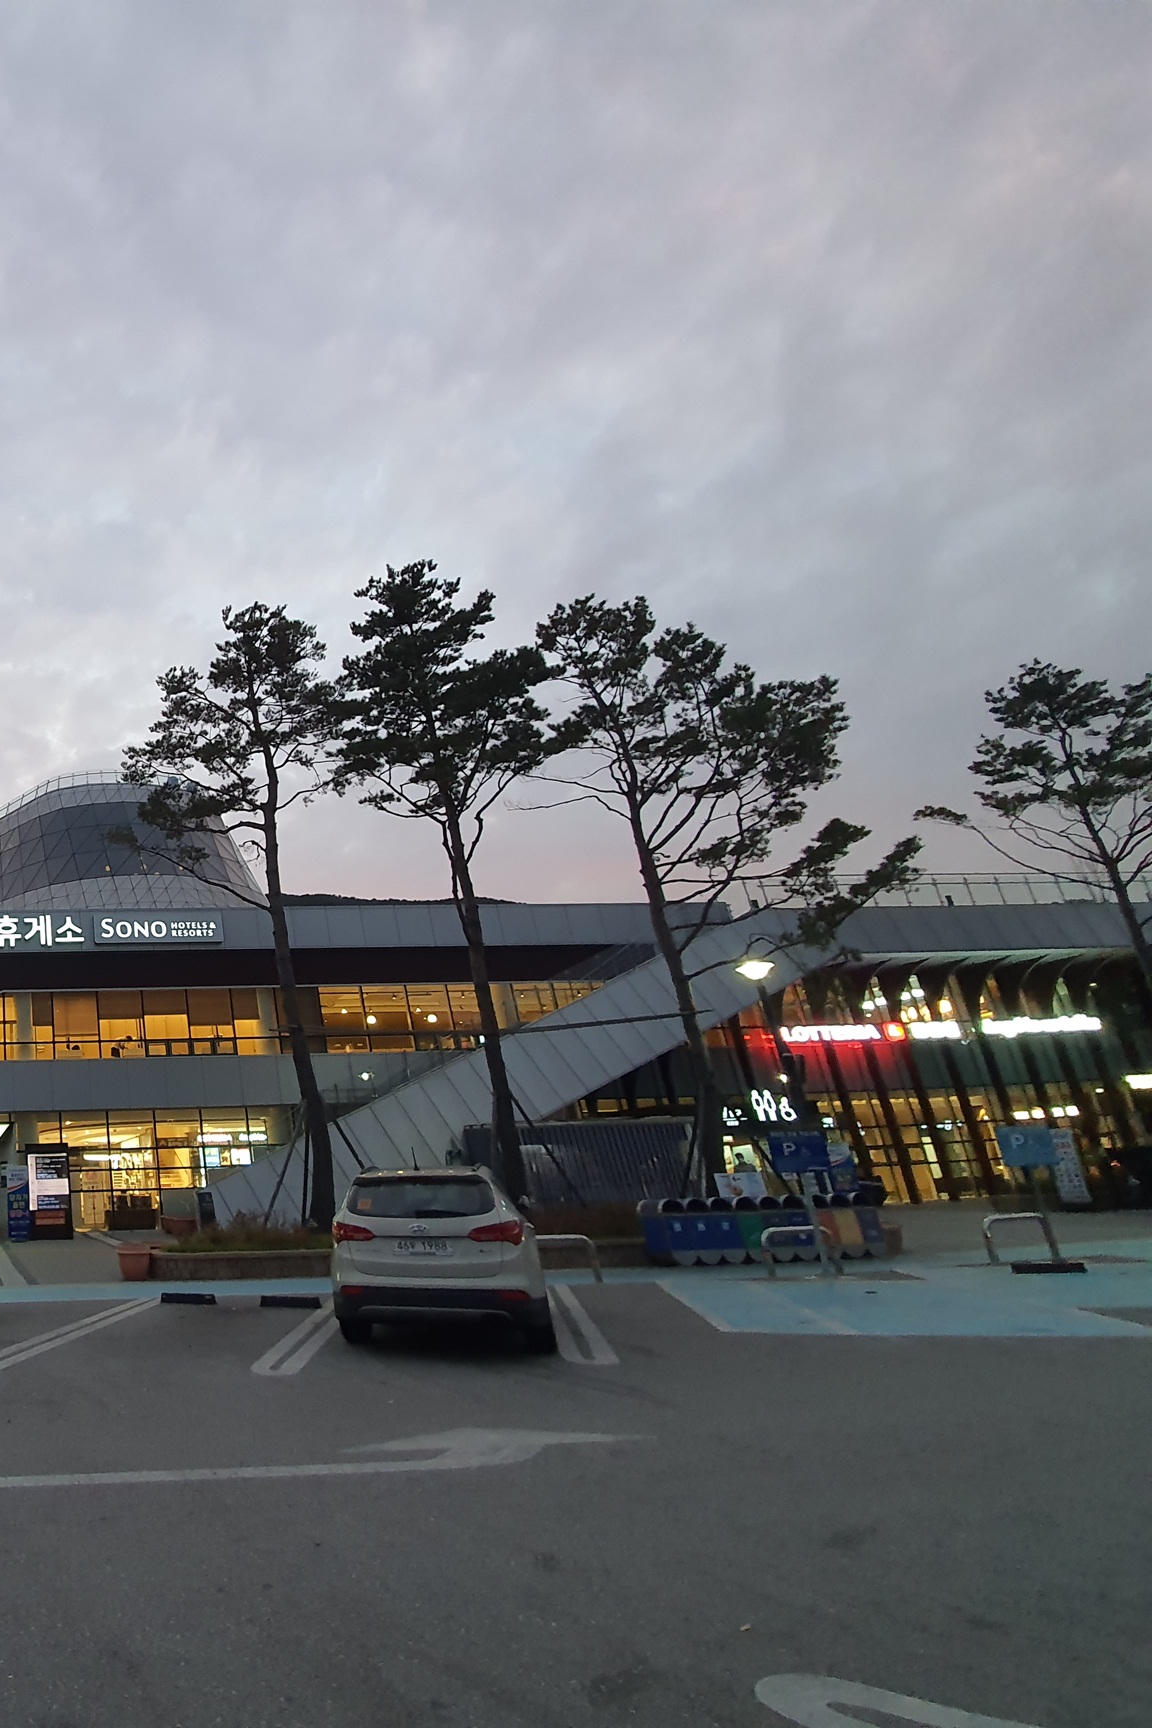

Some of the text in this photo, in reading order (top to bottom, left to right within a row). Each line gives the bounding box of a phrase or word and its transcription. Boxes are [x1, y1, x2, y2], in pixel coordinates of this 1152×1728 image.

[100, 917, 167, 939] SONO
[170, 921, 208, 929] HOTELS
[171, 929, 214, 937] RESORTS
[782, 1142, 796, 1156] P
